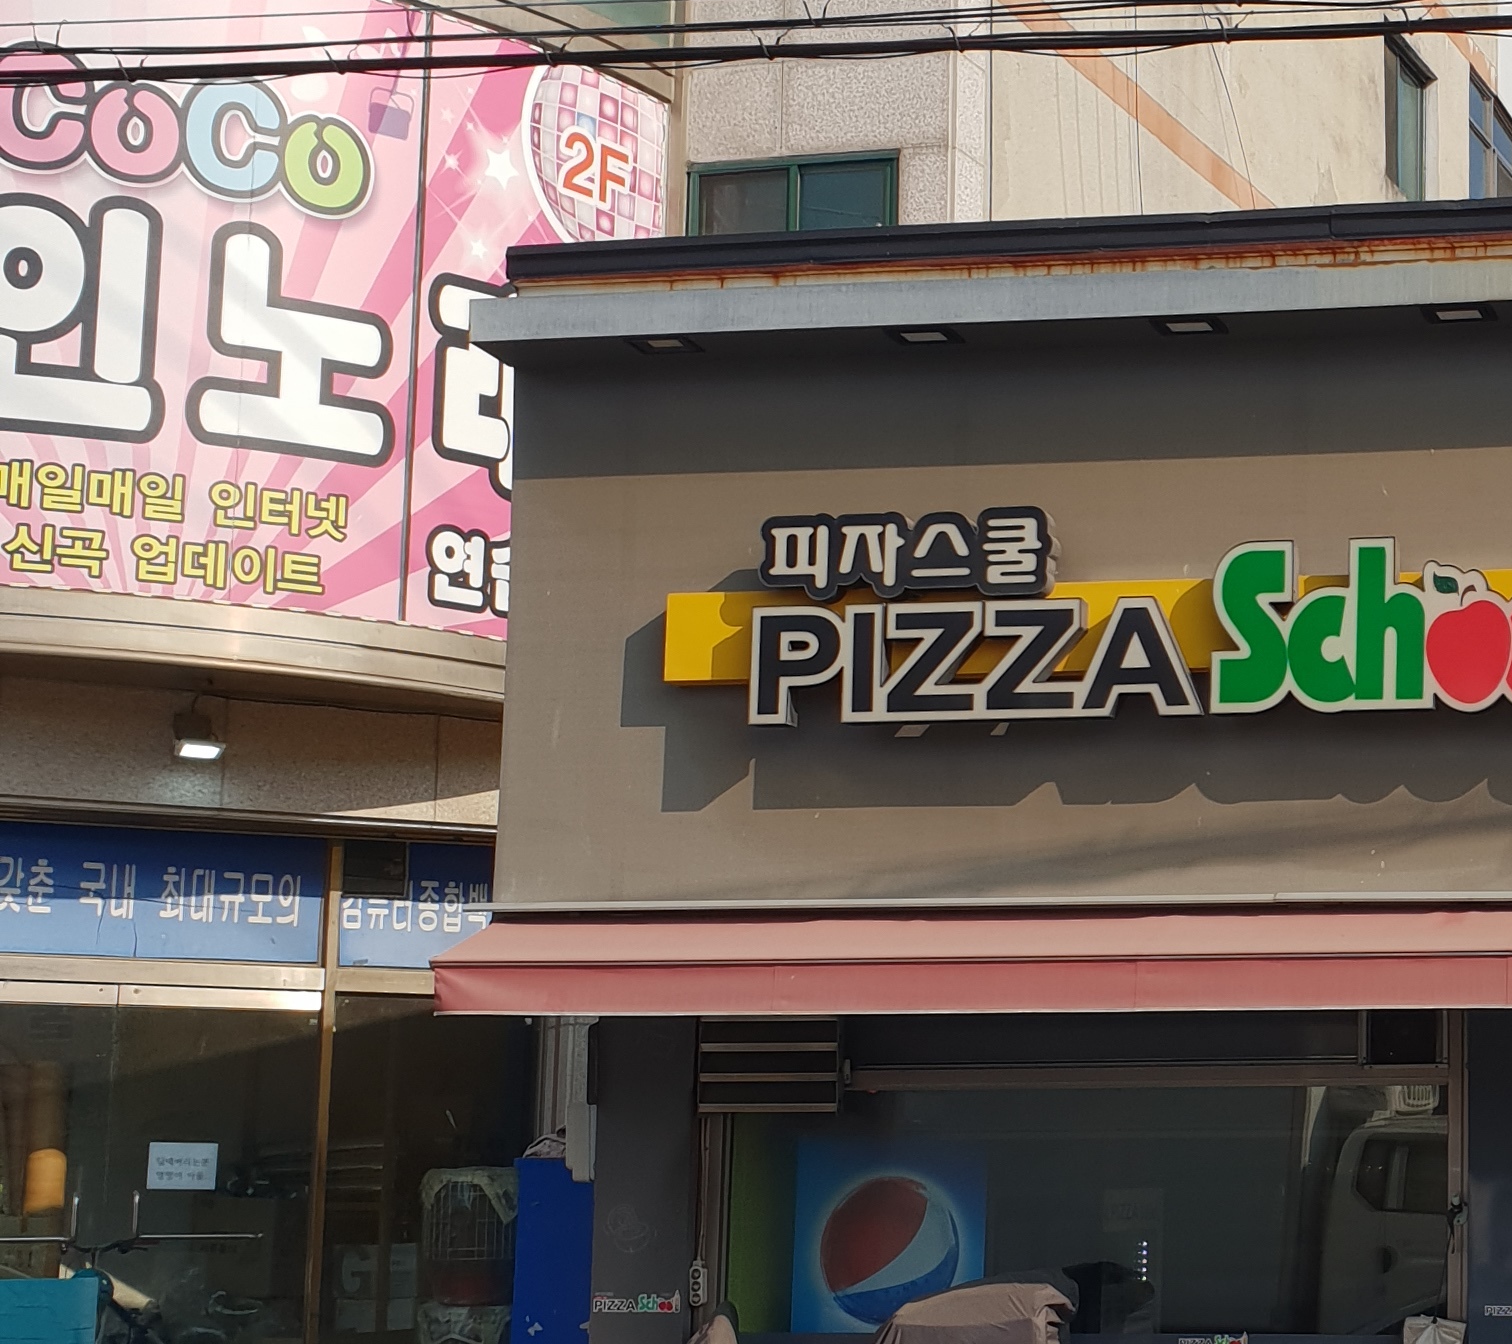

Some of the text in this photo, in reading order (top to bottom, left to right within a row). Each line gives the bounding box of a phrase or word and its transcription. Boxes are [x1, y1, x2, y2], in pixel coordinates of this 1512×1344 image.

[560, 124, 632, 210] 2F
[0, 459, 349, 542] 매일매일 인터넷
[2, 523, 325, 594] 신곡 업데이트
[764, 511, 1050, 593] 피자스쿨
[749, 597, 1203, 726] PIZZA
[79, 861, 136, 919] 국내
[159, 866, 301, 927] 최대규모의
[593, 1298, 637, 1313] PIZZA
